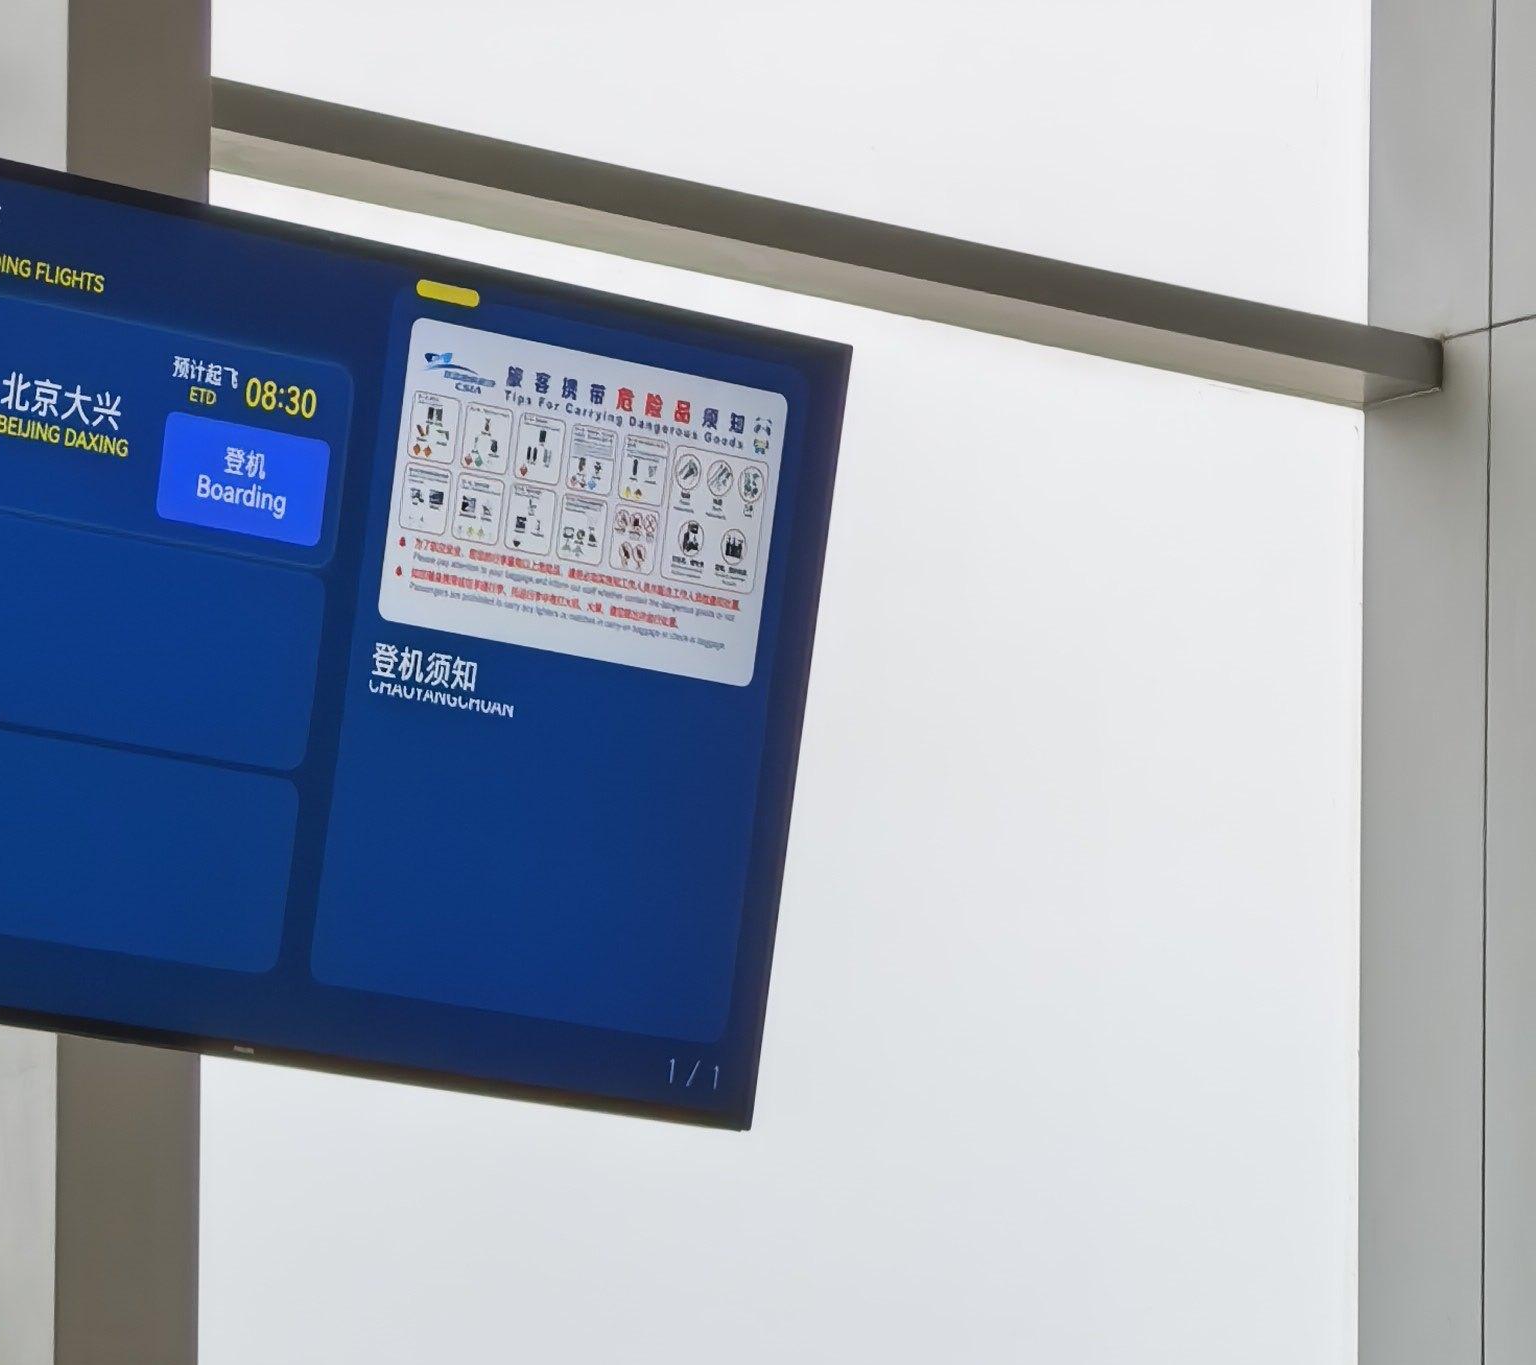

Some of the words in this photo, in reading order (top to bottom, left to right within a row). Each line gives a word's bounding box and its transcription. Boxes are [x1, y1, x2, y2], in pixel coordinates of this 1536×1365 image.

[35, 262, 105, 294] FLIGHTS
[172, 355, 239, 390] 预计起飞
[0, 371, 122, 431] 北京大兴
[189, 387, 217, 406] ETD
[245, 377, 317, 420] 08:30
[64, 427, 129, 458] DAXING
[223, 446, 266, 480] 登机
[196, 474, 287, 520] Boarding
[372, 642, 478, 692] 登机须知
